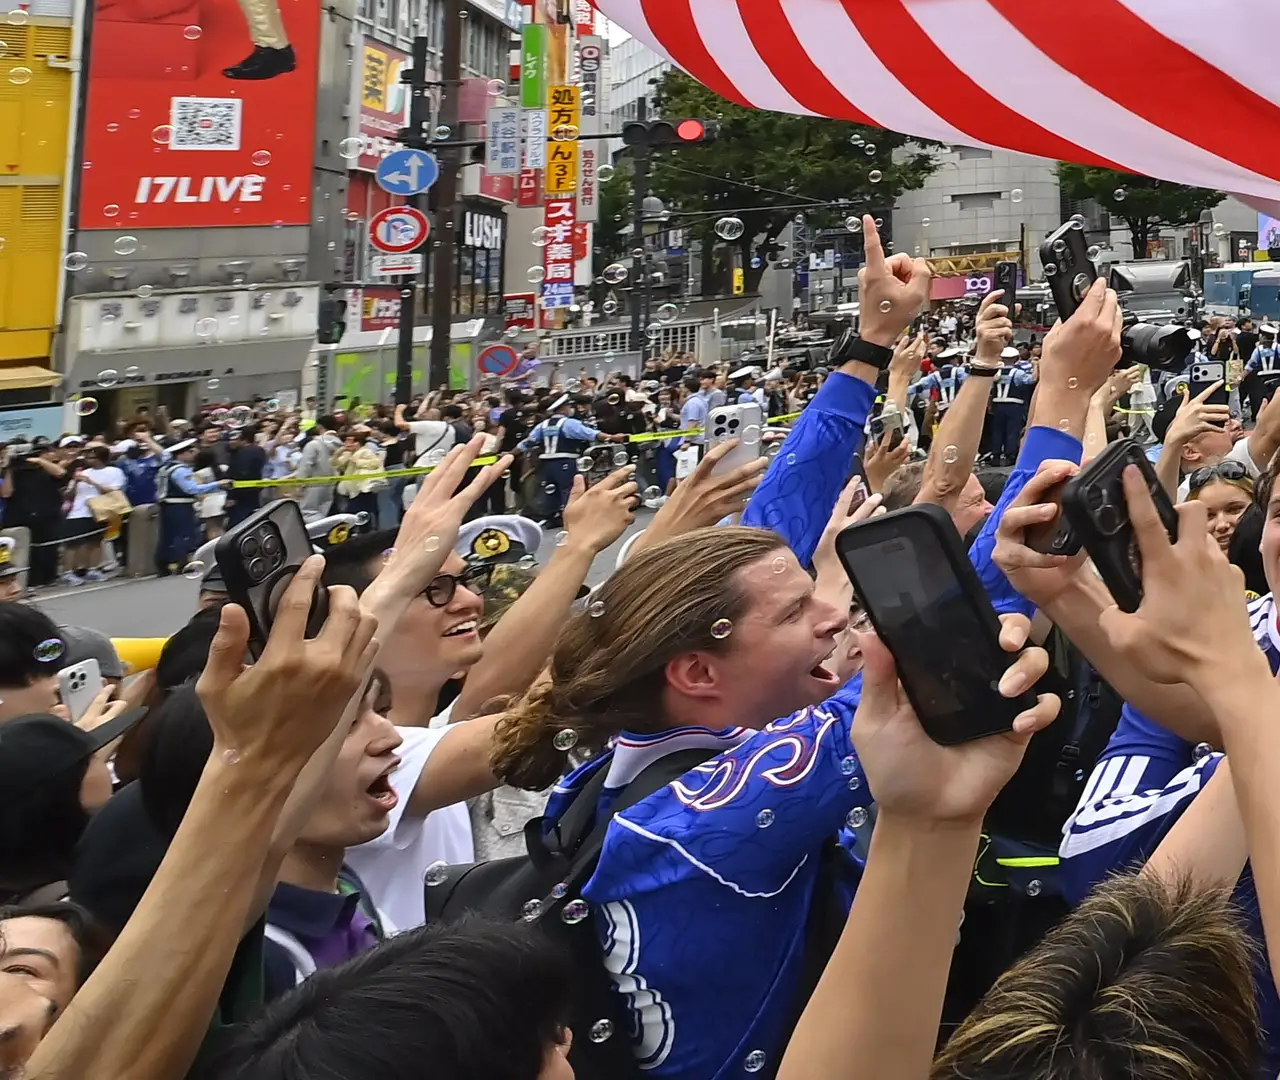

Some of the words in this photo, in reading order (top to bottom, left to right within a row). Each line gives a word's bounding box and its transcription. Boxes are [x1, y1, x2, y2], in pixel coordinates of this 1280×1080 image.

[134, 175, 268, 205] 17LIVE
[555, 164, 568, 189] 3F
[464, 211, 502, 250] LUSH
[545, 201, 575, 279] スギ薬局
[964, 277, 991, 294] 109
